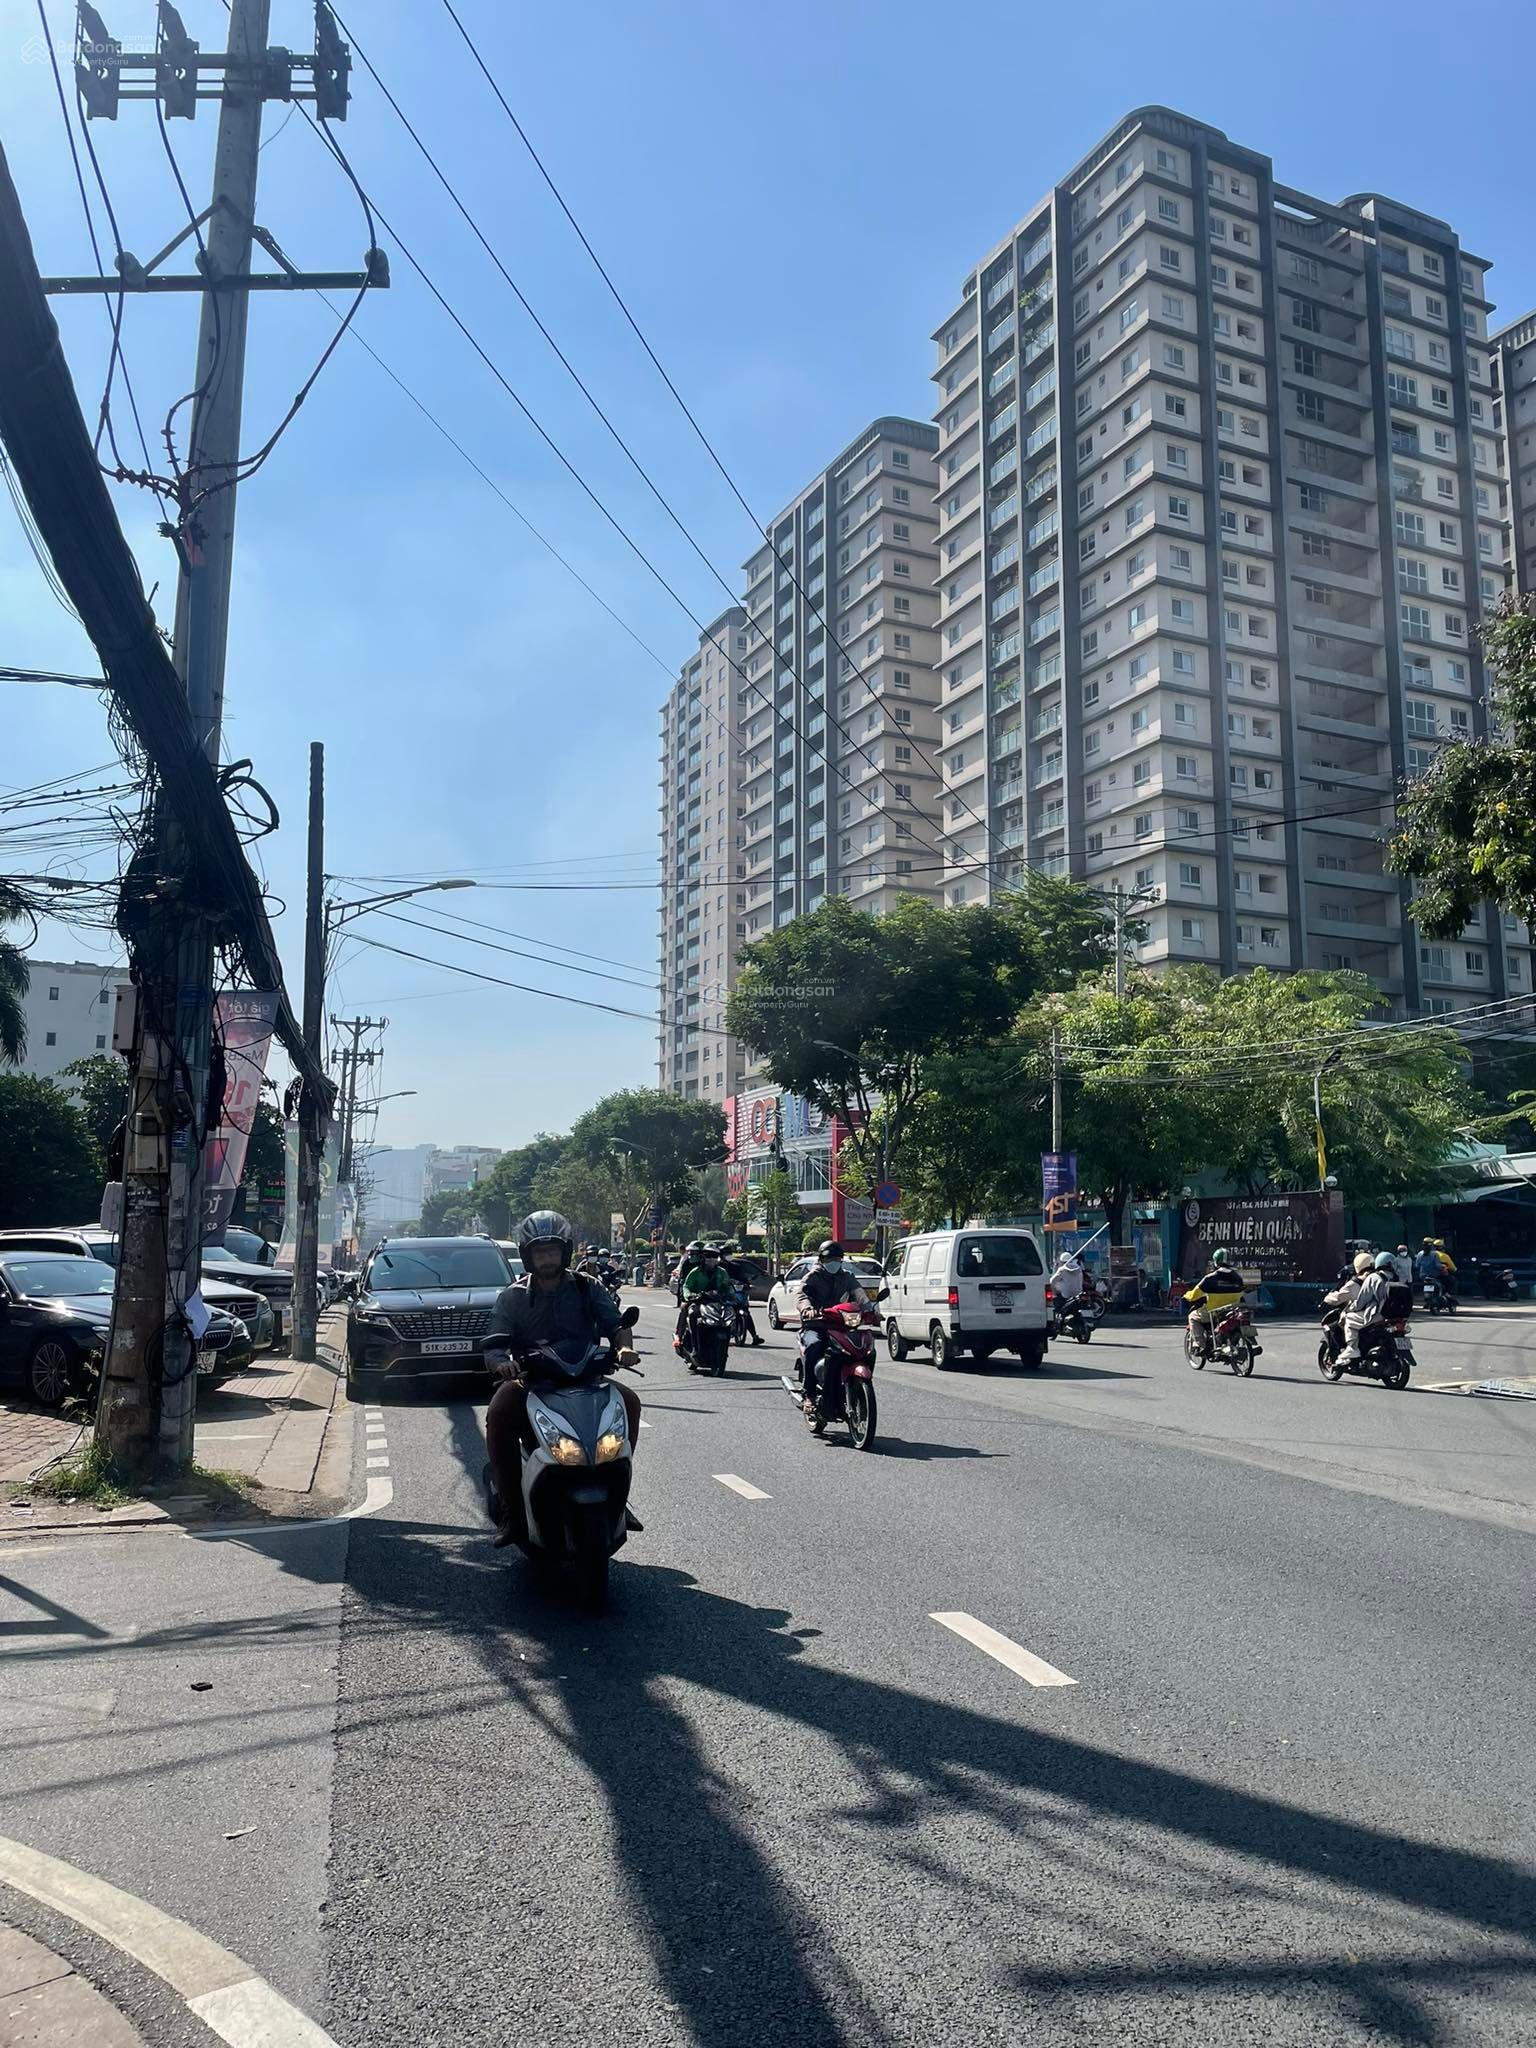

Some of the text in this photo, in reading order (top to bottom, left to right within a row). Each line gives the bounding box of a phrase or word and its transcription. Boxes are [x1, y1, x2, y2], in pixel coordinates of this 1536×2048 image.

[1199, 1215, 1303, 1245] BỆNH VIỆN QUẬN
